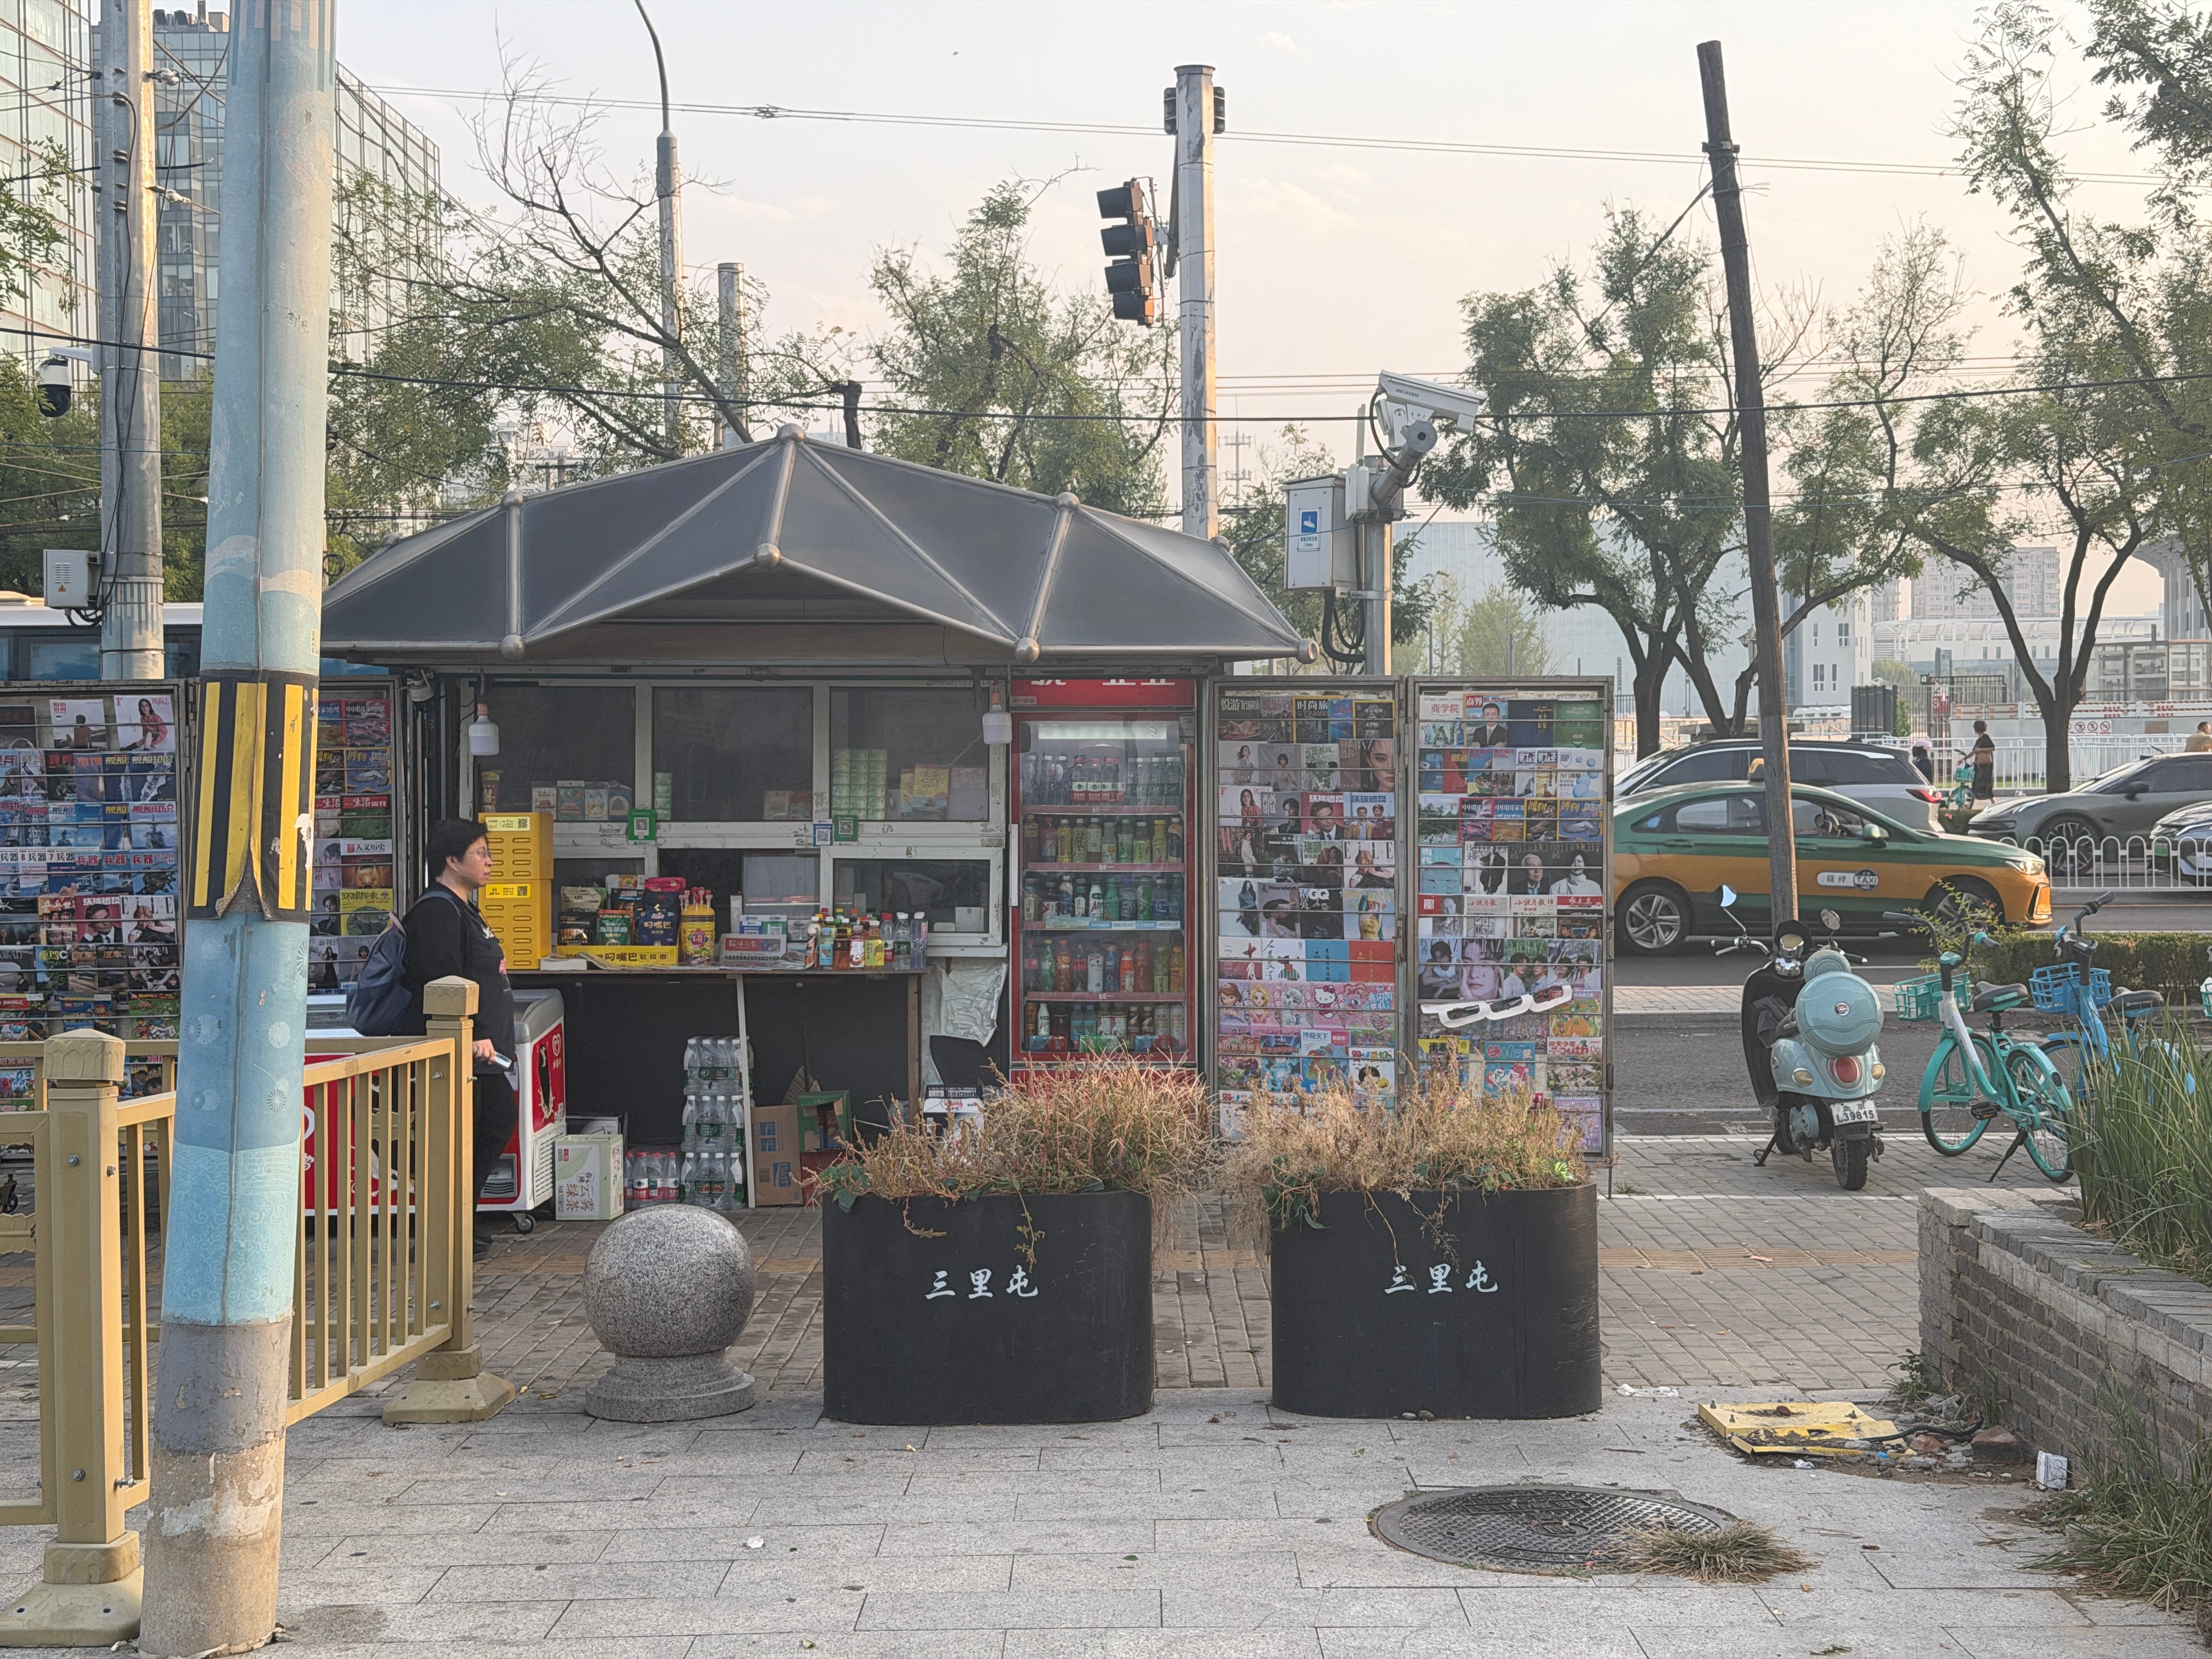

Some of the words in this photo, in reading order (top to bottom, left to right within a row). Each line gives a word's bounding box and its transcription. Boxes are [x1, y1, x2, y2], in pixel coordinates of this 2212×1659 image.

[1466, 697, 1483, 707] 商界
[1431, 703, 1460, 714] 商学院
[1538, 752, 1556, 764] 财经
[1345, 842, 1393, 860] ELE
[76, 855, 98, 865] 兵器
[104, 854, 126, 865] 兵器
[132, 854, 153, 864] 兵器
[1856, 876, 1877, 884] TAXI
[1308, 889, 1330, 900] GQ
[122, 896, 173, 915] ELE
[1836, 1110, 1875, 1123] L39815
[925, 1264, 1039, 1300] 三里屯
[1384, 1260, 1499, 1294] 三里屯
